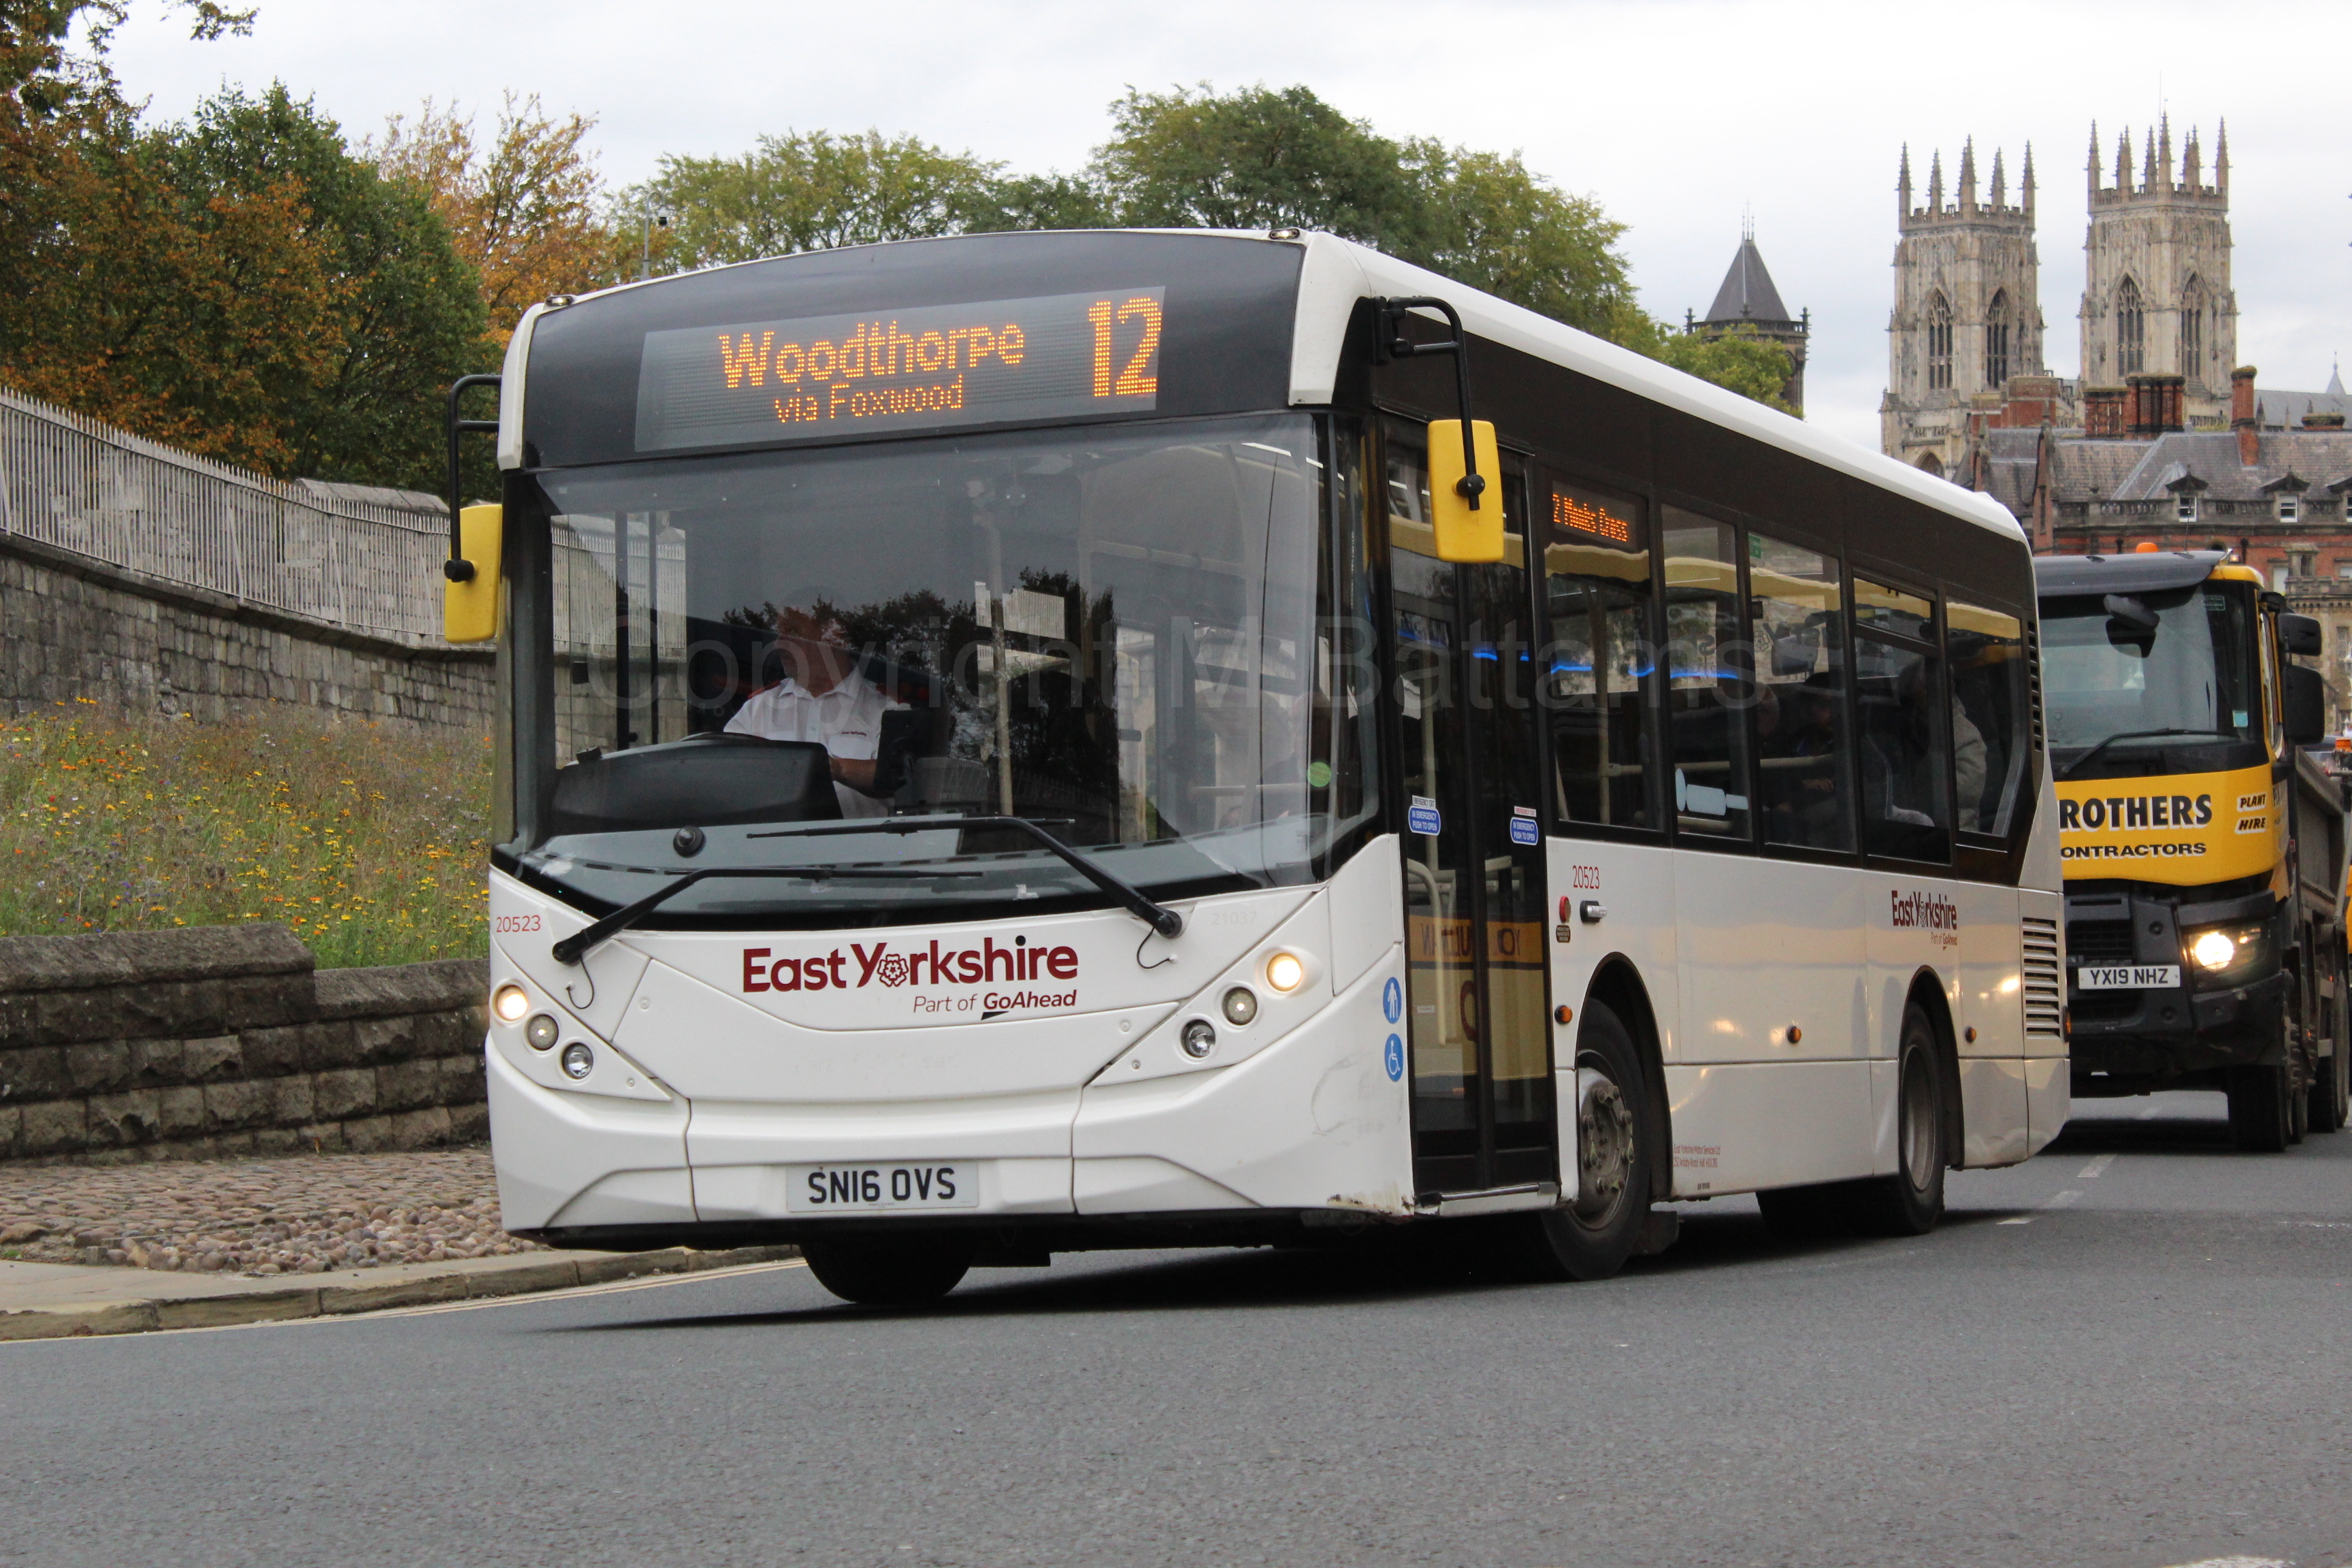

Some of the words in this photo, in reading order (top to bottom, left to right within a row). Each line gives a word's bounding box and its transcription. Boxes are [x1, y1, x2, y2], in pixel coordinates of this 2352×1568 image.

[719, 321, 1024, 389] Woodthorpe
[1089, 297, 1162, 397] 12
[774, 388, 817, 423] via
[830, 374, 963, 419] Foxwood
[2058, 794, 2212, 830] ROTHERS
[2240, 794, 2266, 808] PLANT
[2238, 817, 2266, 830] HIRE
[2060, 843, 2207, 858] ONTRACTORS
[1573, 865, 1600, 889] 20523
[496, 915, 541, 932] 20523
[2090, 968, 2129, 985] YX19
[2134, 968, 2168, 985] NHZ
[913, 995, 952, 1013] Part
[957, 993, 977, 1011] of
[983, 989, 1077, 1010] GoAhead
[808, 1170, 881, 1204] SN16
[892, 1167, 956, 1201] OVS
